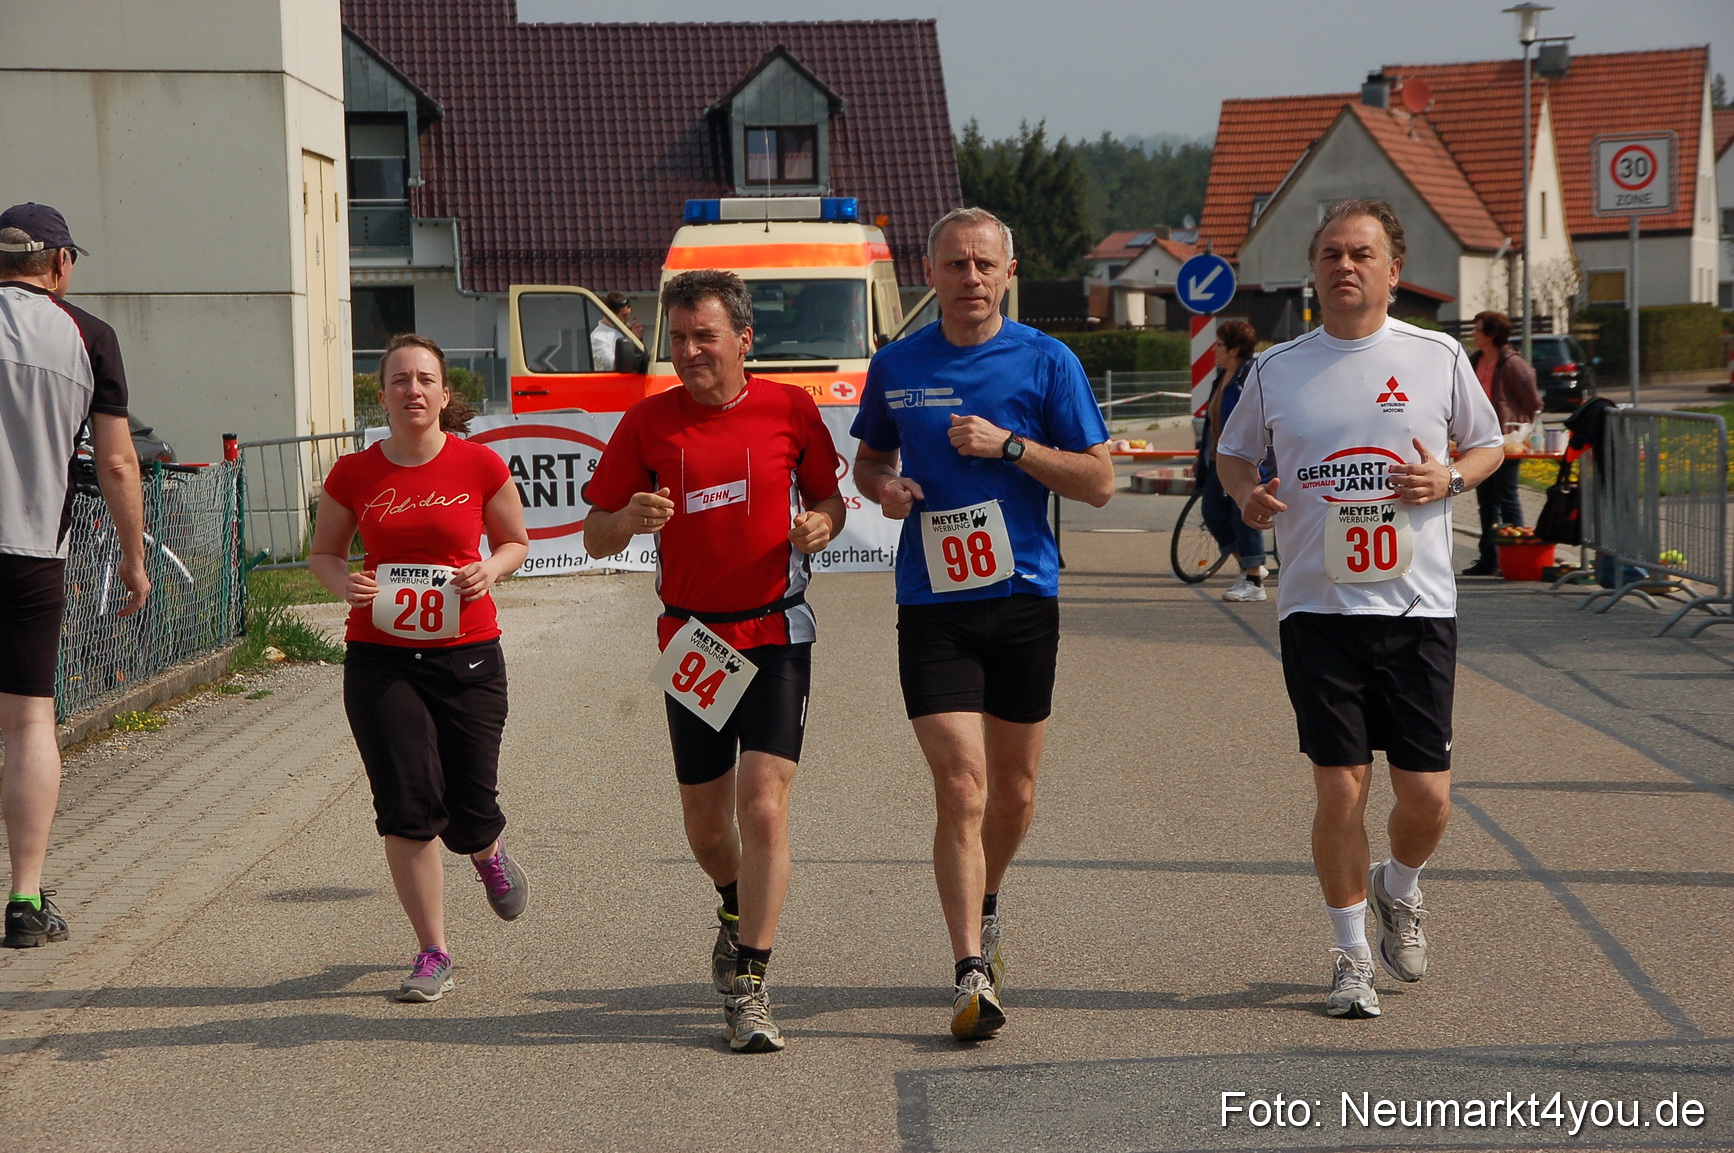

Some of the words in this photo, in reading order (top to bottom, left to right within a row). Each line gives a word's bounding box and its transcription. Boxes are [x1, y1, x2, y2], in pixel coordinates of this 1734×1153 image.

[1619, 157, 1648, 178] 30
[1616, 192, 1653, 206] ZONE
[507, 452, 582, 480] ART
[1296, 461, 1387, 481] GERHART
[1301, 480, 1336, 489] AUTOHAUS
[361, 487, 470, 523] Adidas
[702, 489, 730, 504] DEHN
[931, 512, 968, 526] MEYER
[1339, 505, 1379, 516] MEYER
[1339, 515, 1380, 523] WERBUNG
[932, 521, 971, 533] WERBUNG
[942, 531, 997, 582] 98
[1346, 524, 1398, 573] 30
[521, 552, 589, 572] genthal
[389, 568, 429, 577] MEYER
[389, 577, 430, 585] WERBUNG
[393, 588, 444, 632] 28
[690, 635, 725, 664] WERBUNG
[693, 628, 730, 658] MEYER
[672, 651, 727, 710] 94
